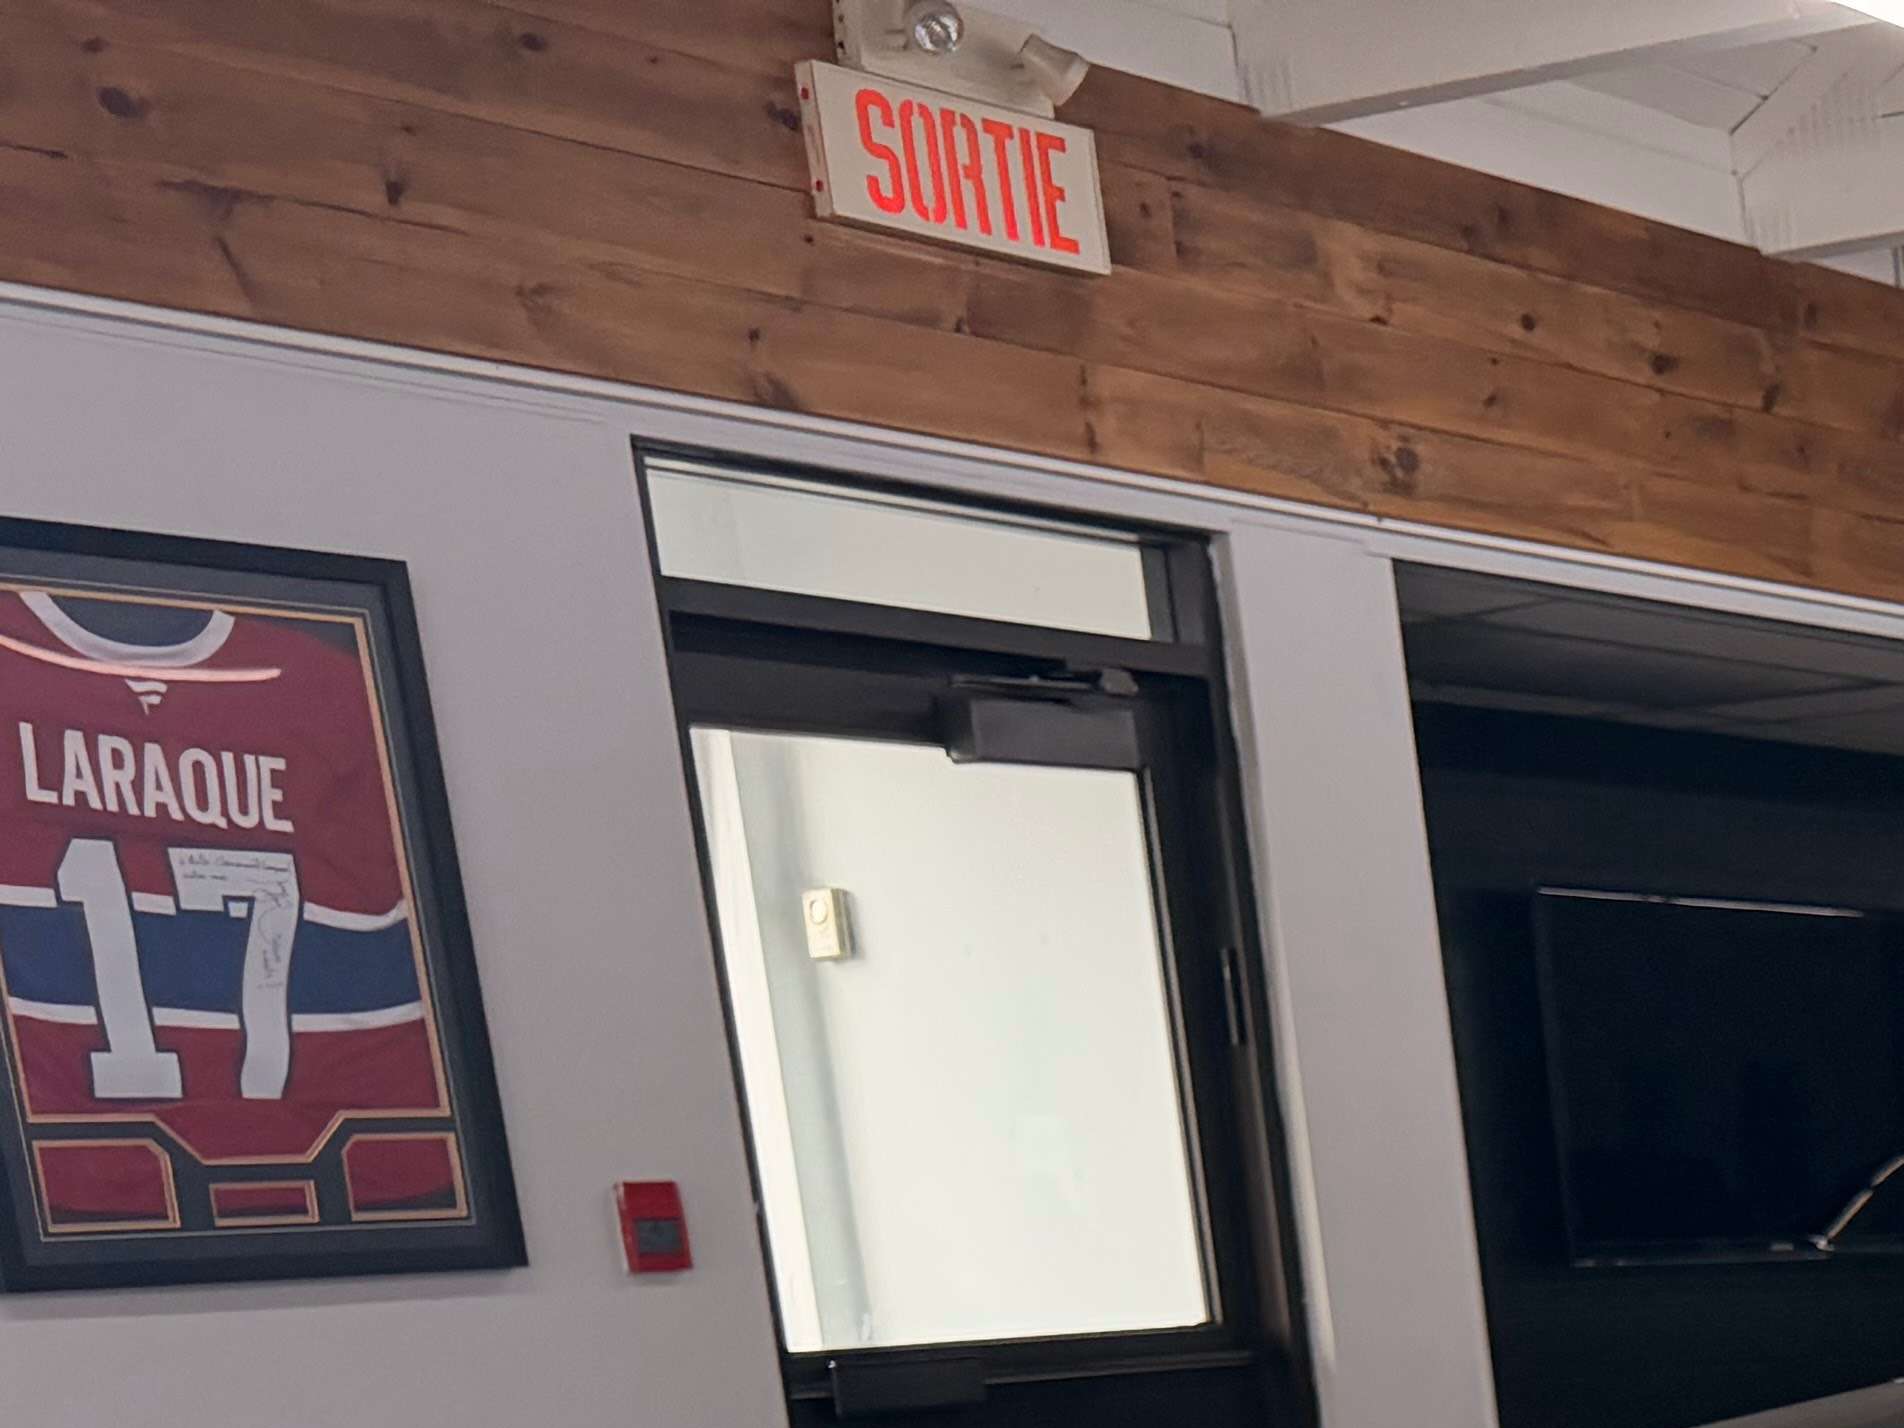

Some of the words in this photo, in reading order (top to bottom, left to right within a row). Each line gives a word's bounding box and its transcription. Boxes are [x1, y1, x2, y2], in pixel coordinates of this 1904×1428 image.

[855, 88, 1080, 254] SORTIE
[19, 721, 294, 832] LARAQUE
[57, 838, 299, 1100] 17
